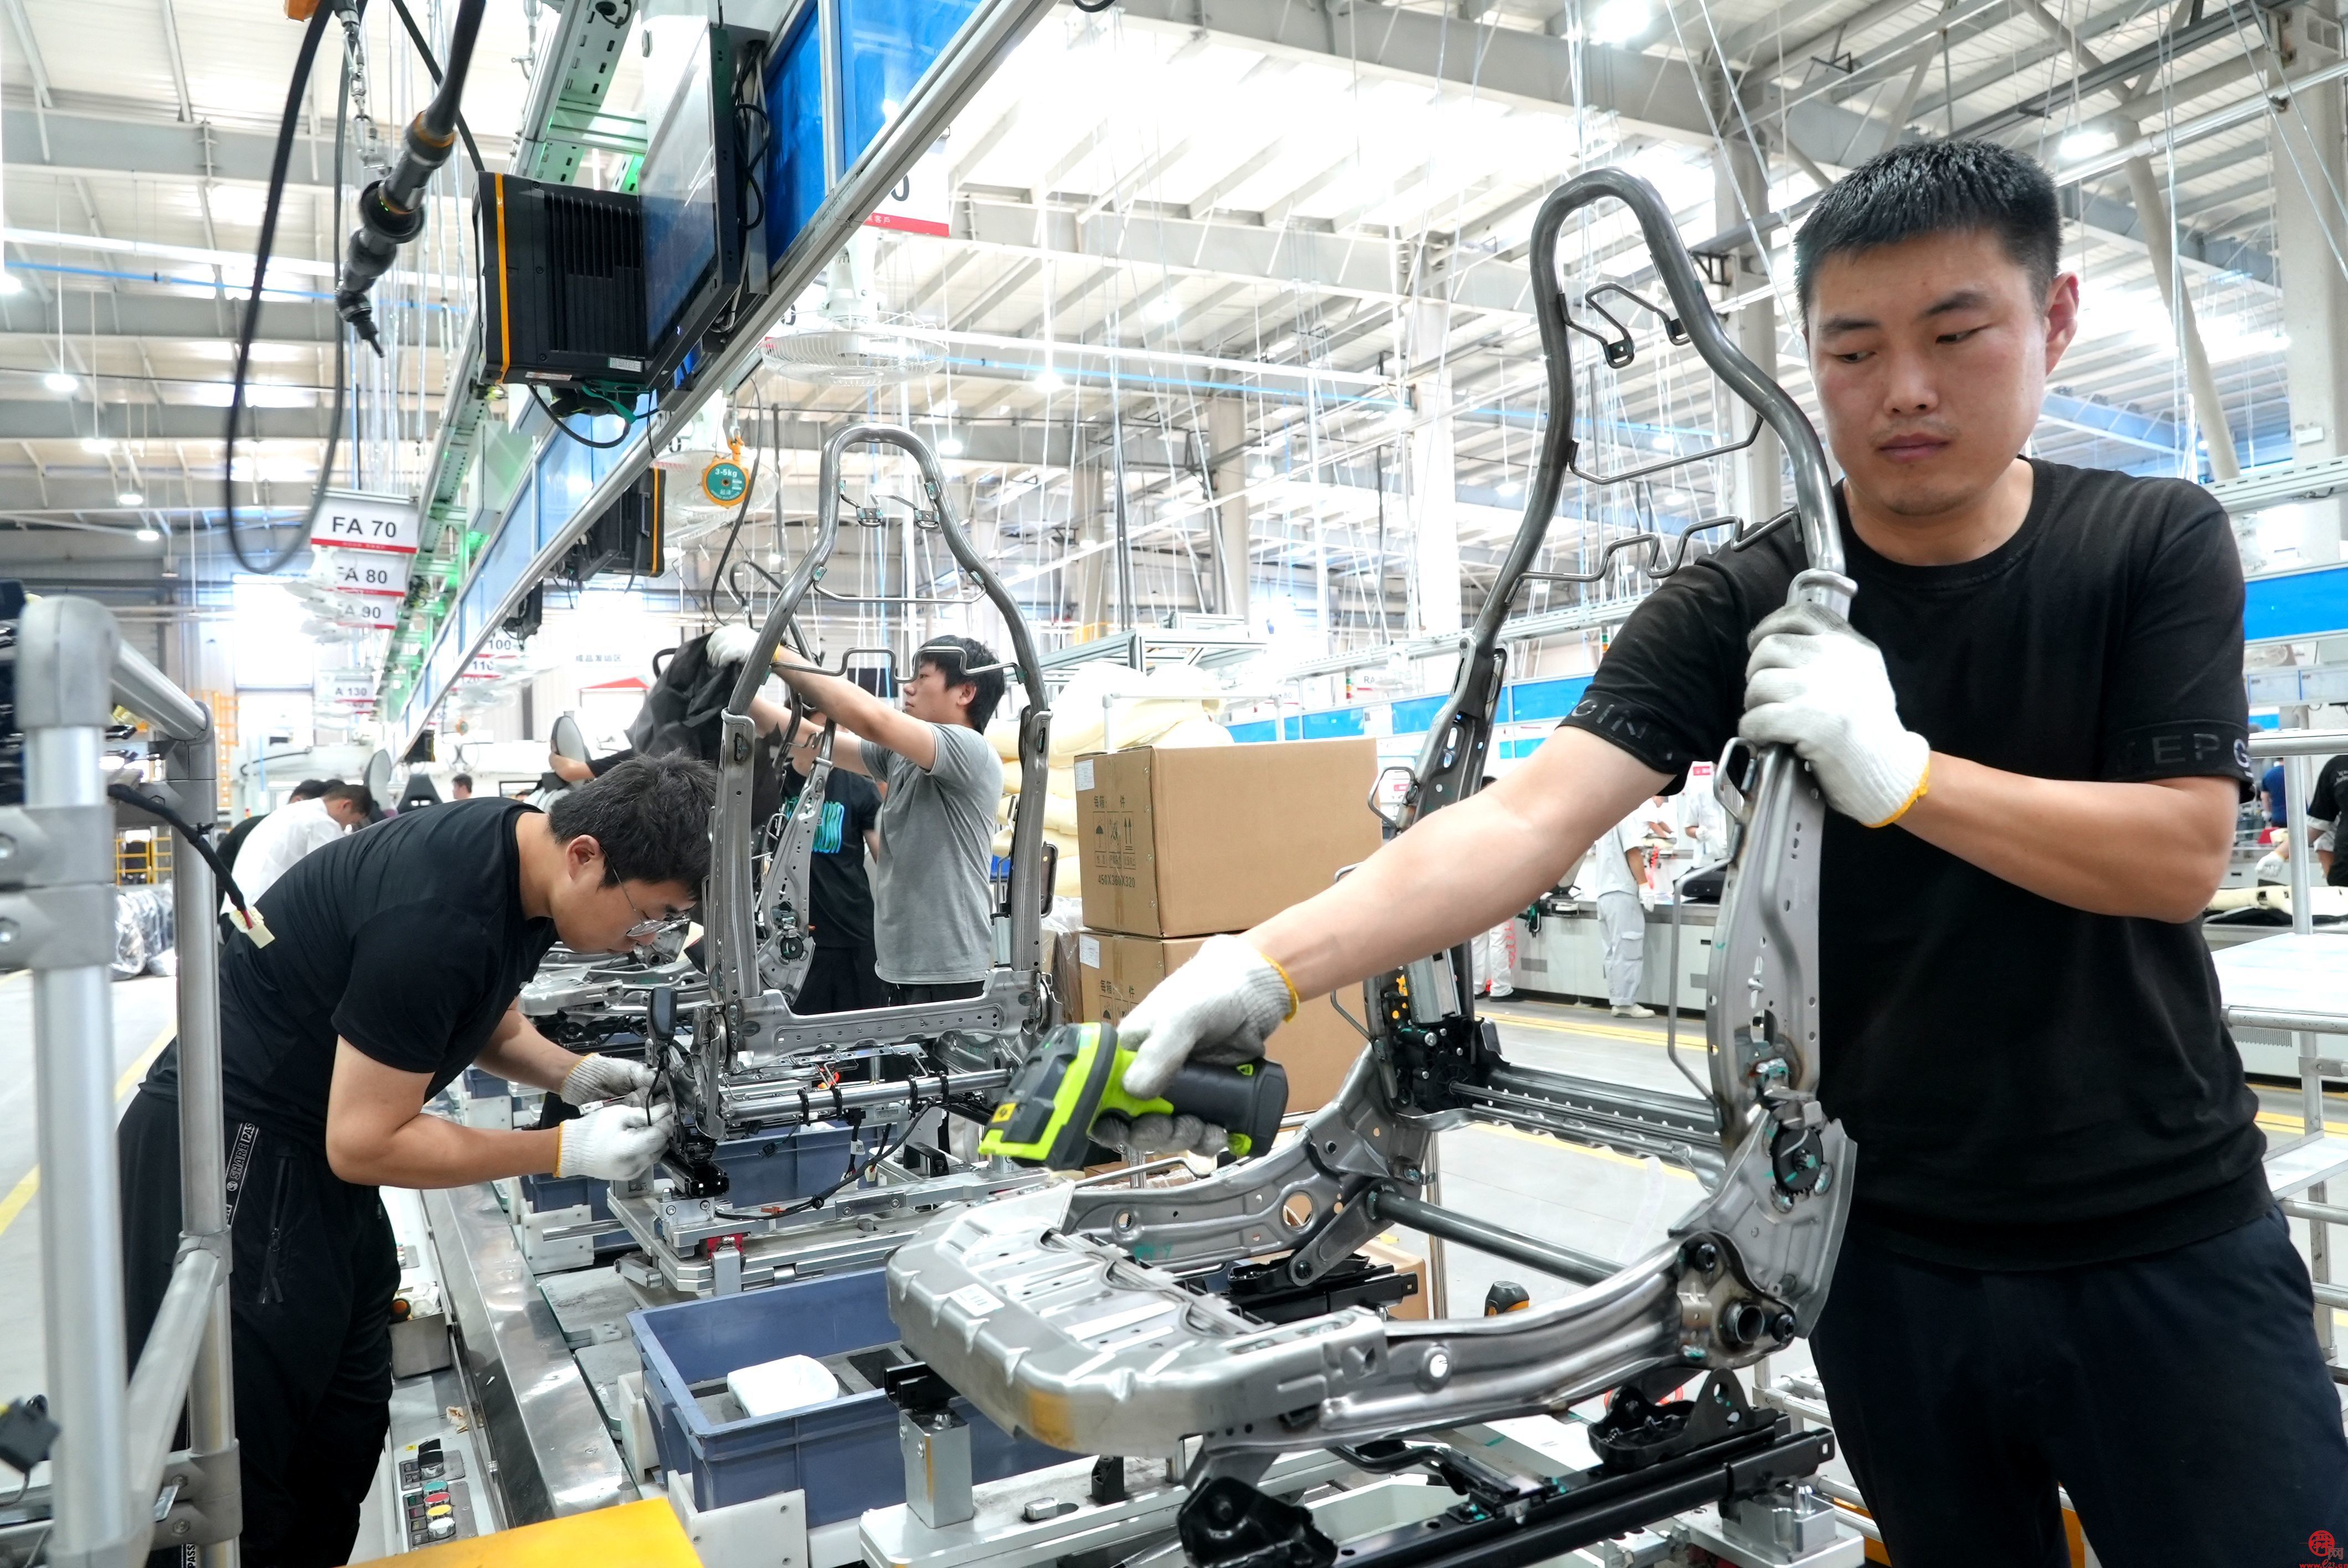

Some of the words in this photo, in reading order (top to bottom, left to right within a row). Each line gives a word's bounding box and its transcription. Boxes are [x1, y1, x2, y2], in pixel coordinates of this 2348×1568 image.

[714, 468, 738, 478] 3-5kg
[332, 516, 363, 535] FA
[371, 520, 397, 538] 70
[366, 570, 388, 584] 80
[337, 603, 356, 616] A
[362, 606, 382, 620] 90
[488, 639, 511, 650] 100
[348, 688, 368, 696] 130
[1120, 795, 1126, 809] 件
[1129, 985, 1135, 1000] 件
[229, 1142, 249, 1180] SHARE
